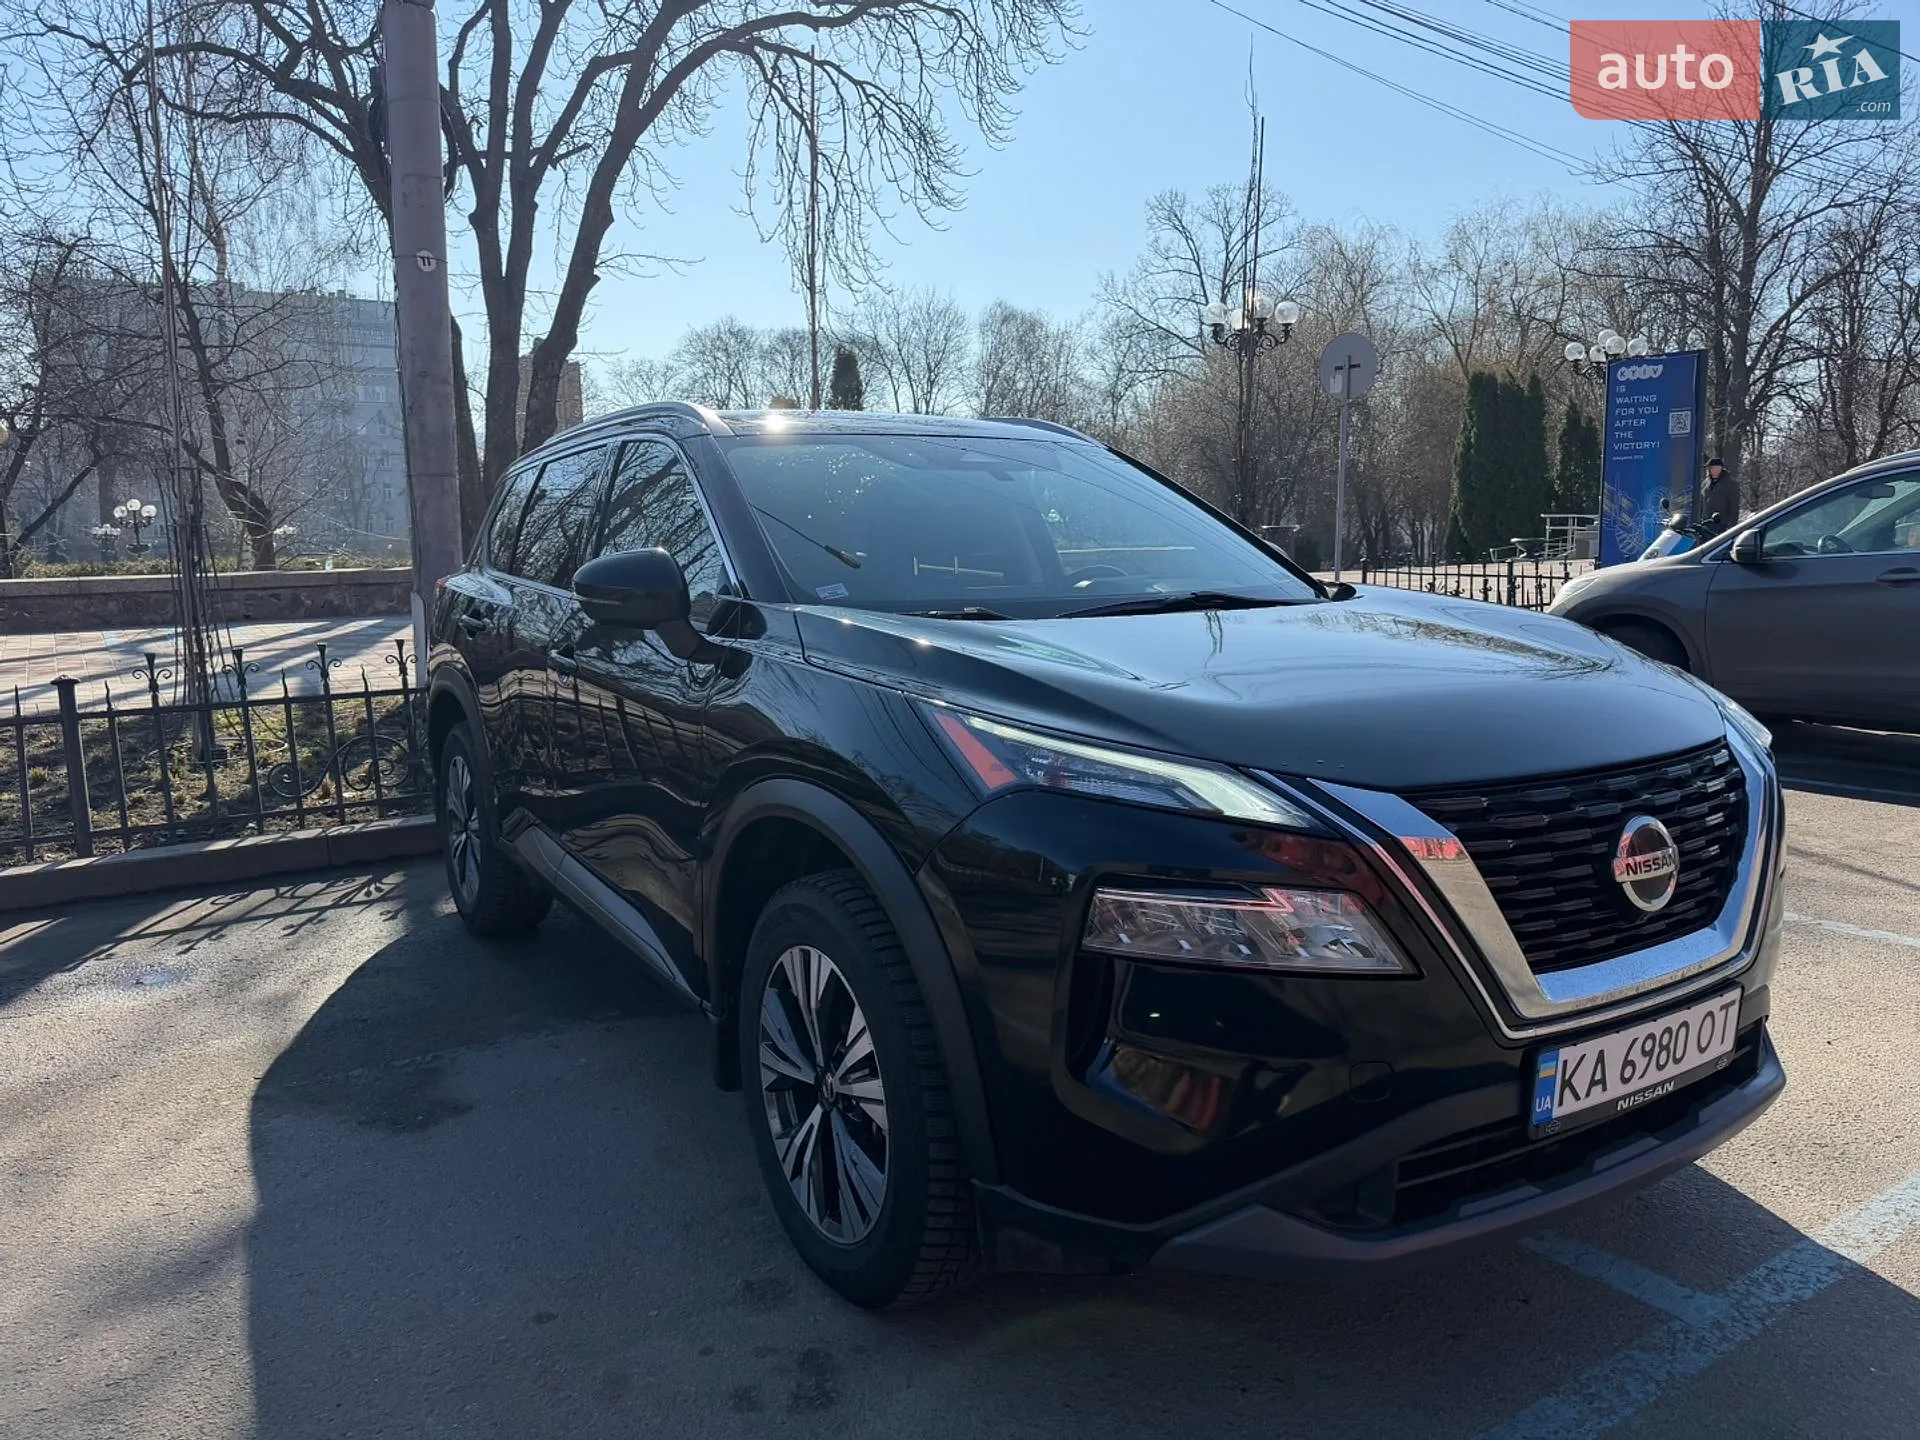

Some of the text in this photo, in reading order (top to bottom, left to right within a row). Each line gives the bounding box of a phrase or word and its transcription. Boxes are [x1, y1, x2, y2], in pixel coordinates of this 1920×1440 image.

[1618, 364, 1663, 381] KYIV
[1616, 385, 1626, 393] IS
[1615, 395, 1657, 404] WAITING
[1614, 406, 1659, 416] FOR YOU
[1614, 419, 1646, 428] AFTER
[1614, 431, 1634, 439] THE
[1613, 441, 1660, 450] VICTORY!
[1626, 855, 1677, 877] NISSAN
[1557, 999, 1736, 1107] KA 6980 OT
[1616, 1082, 1675, 1111] NISSAN
[1535, 1096, 1552, 1112] UA
